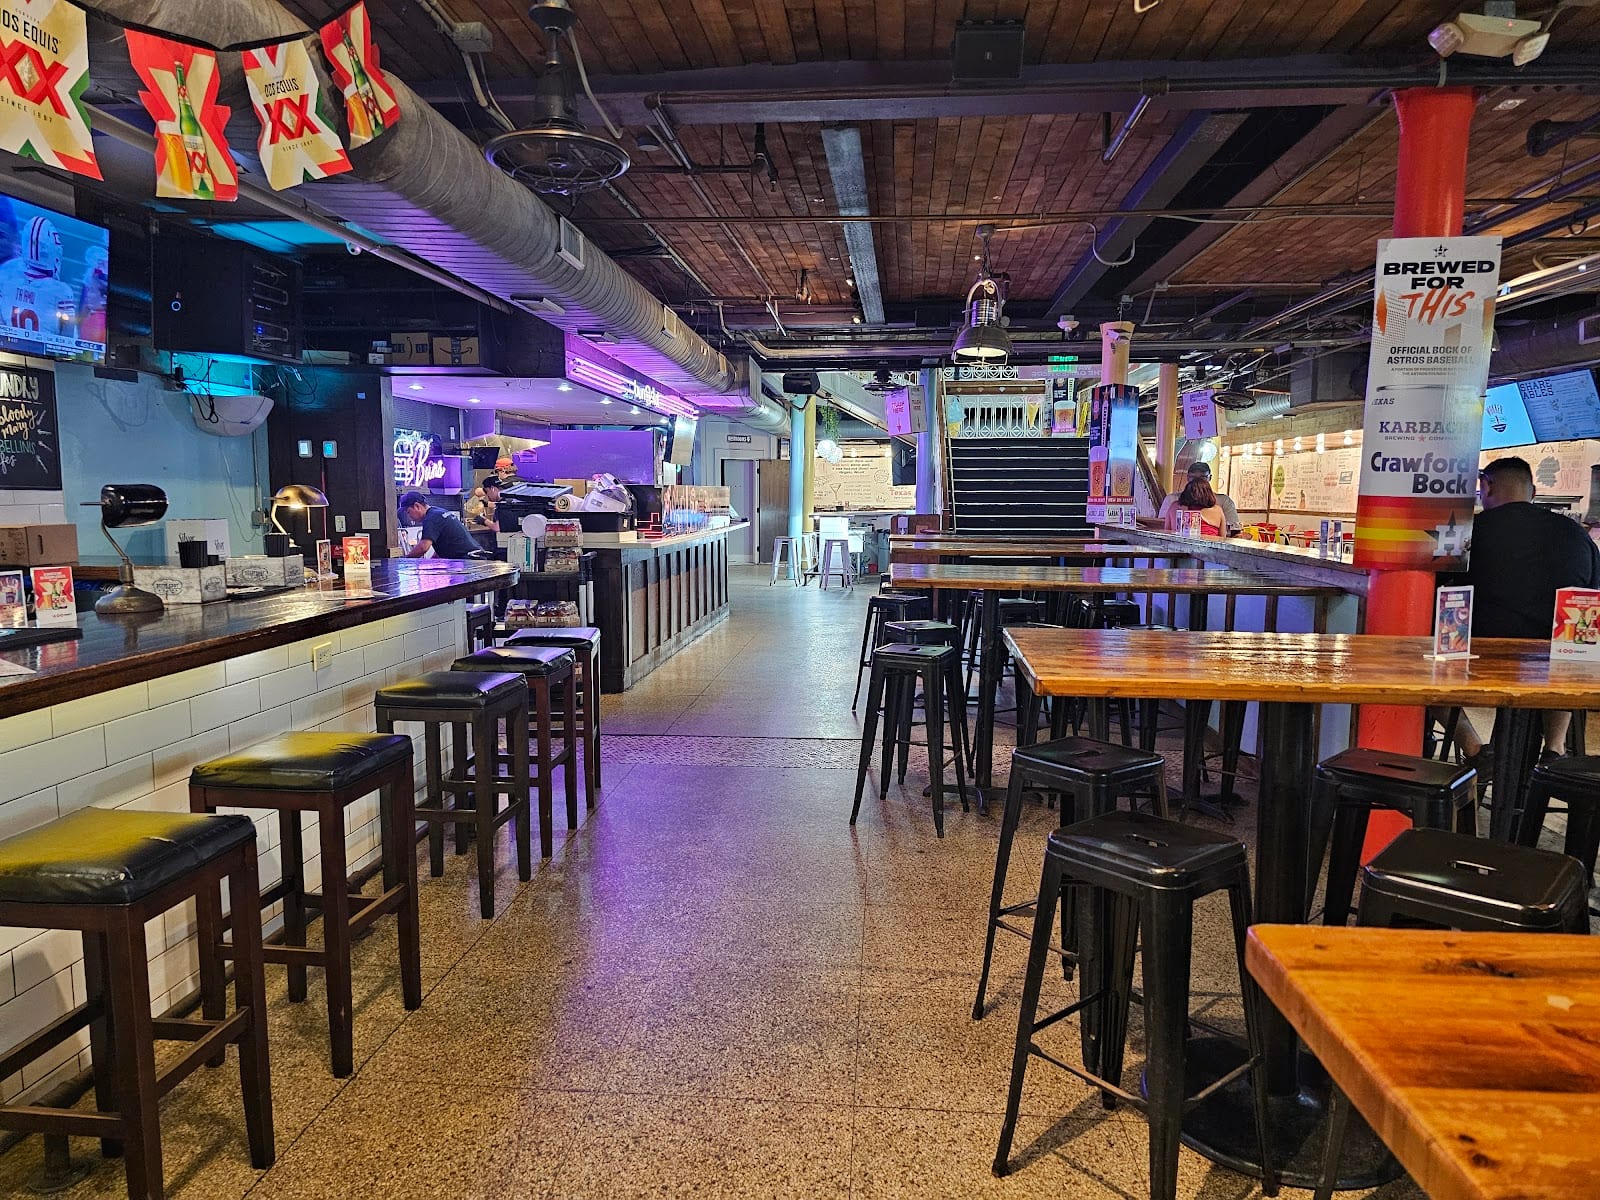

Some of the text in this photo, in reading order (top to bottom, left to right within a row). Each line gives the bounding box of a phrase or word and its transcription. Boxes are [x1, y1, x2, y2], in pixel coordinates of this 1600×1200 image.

[0, 8, 58, 55] OS EQUIS
[276, 77, 300, 95] EQUIS
[1383, 260, 1495, 276] BREWED
[1411, 276, 1465, 290] FOR
[1398, 285, 1476, 326] THIS
[1390, 346, 1431, 355] OFFICIAL
[1432, 345, 1459, 354] BOCK
[1386, 356, 1425, 365] ASTROS
[1520, 379, 1553, 392] SHARE
[1523, 388, 1554, 400] ABLES
[1379, 421, 1468, 434] KARBAC
[1370, 451, 1470, 474] Crawford
[1412, 473, 1468, 494] Bock
